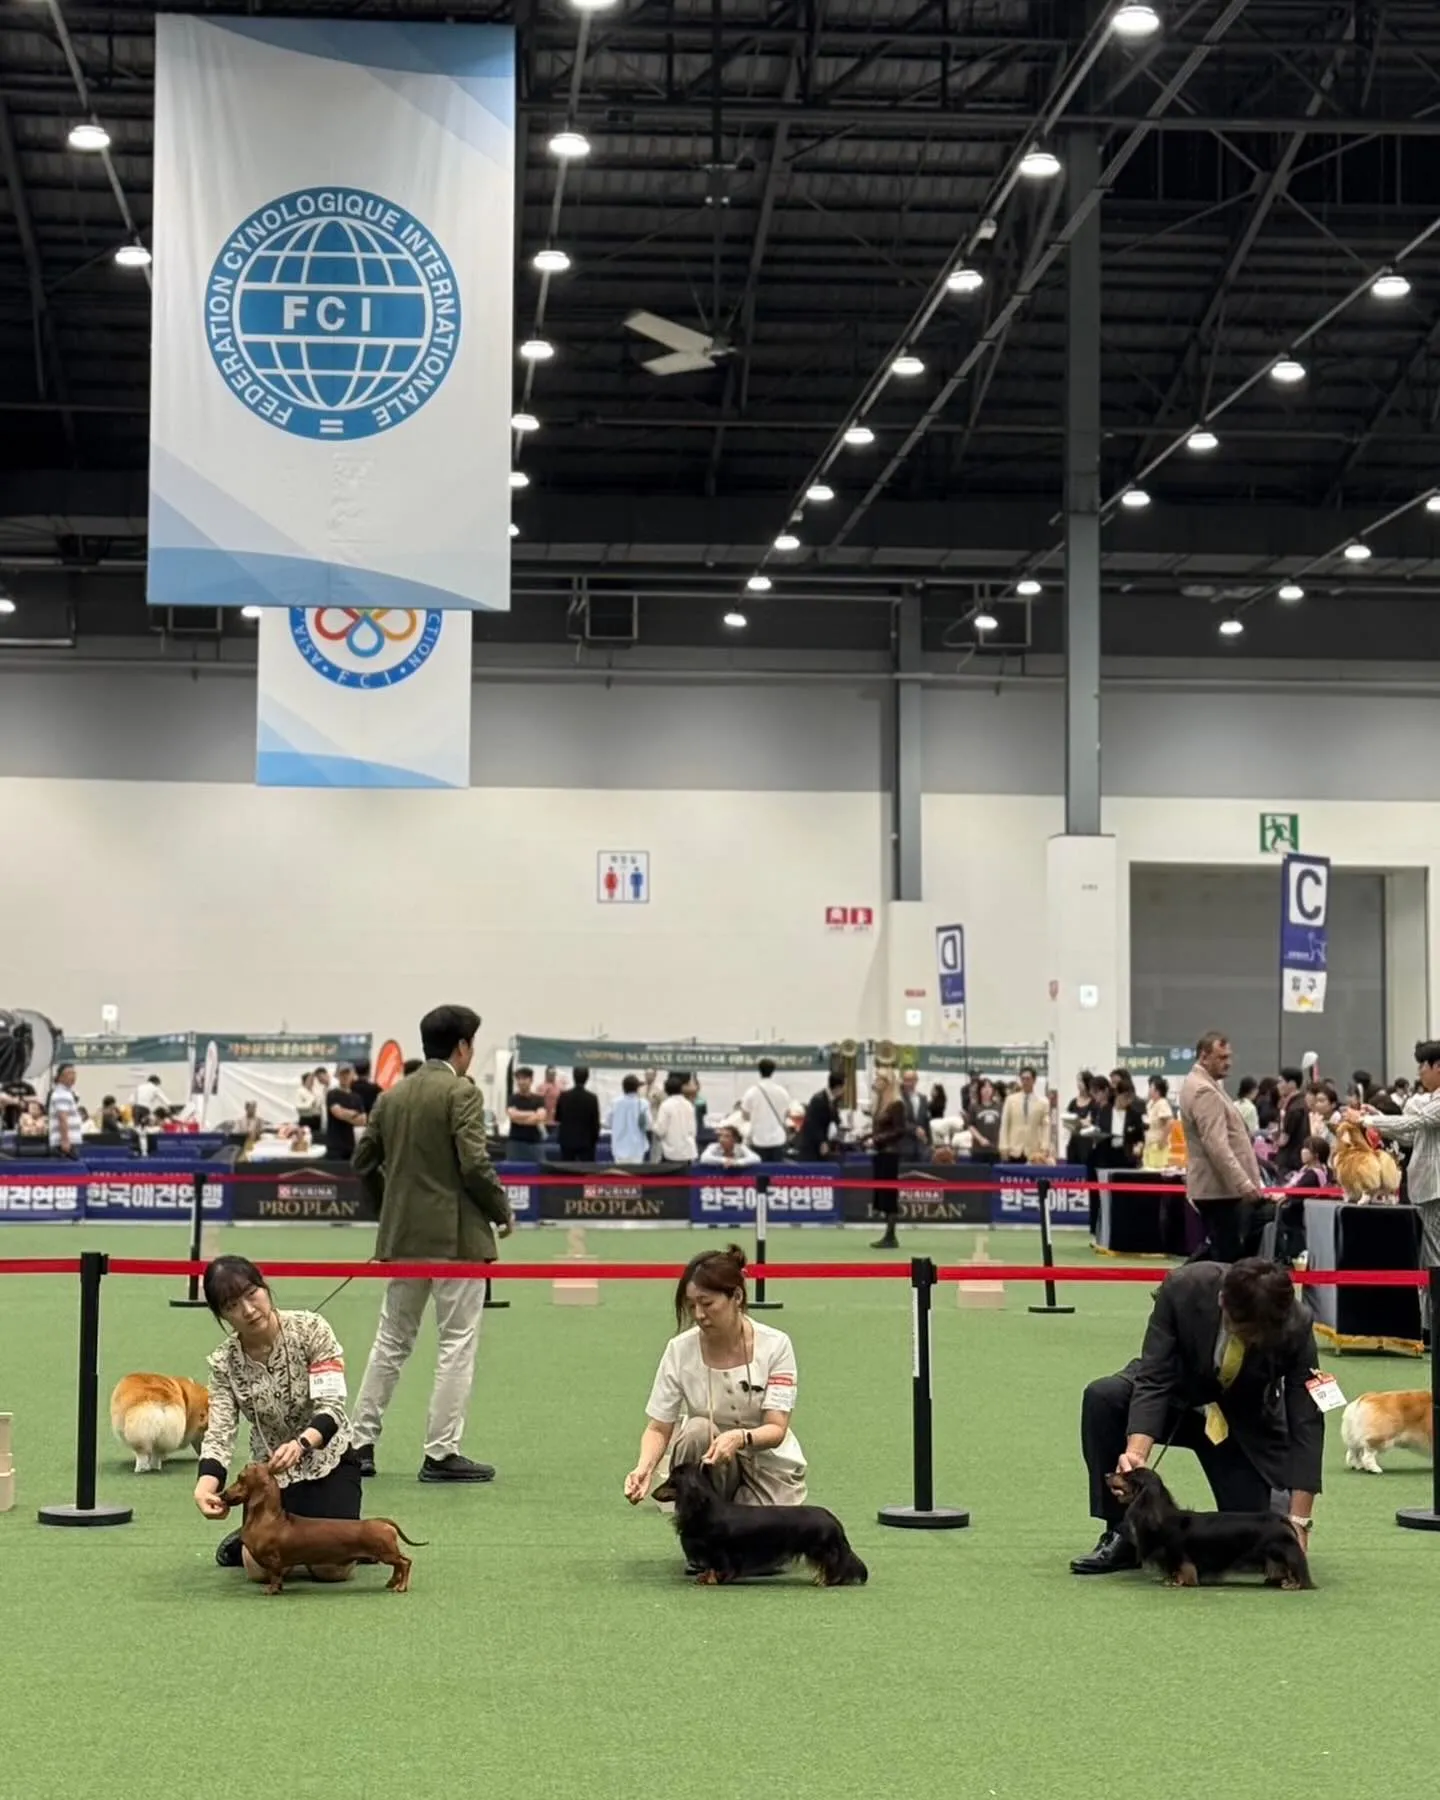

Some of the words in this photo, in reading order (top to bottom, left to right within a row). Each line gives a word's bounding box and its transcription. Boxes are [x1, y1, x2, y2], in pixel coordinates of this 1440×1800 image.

[222, 192, 401, 271] CYNOLOGIQUE
[283, 295, 372, 332] FCI
[371, 223, 457, 428] INTERNATIONALE
[209, 275, 294, 426] FEDERATION
[336, 671, 392, 689] FCI
[1296, 868, 1322, 921] C
[87, 1182, 224, 1209] 한국애견연맹
[291, 1186, 333, 1197] PURINA
[598, 1186, 638, 1197] PURINA
[899, 1189, 940, 1200] PURINA
[258, 1200, 301, 1216] PRO
[303, 1200, 356, 1217] PLAN
[564, 1200, 607, 1216] PRO
[608, 1200, 660, 1217] PLAN
